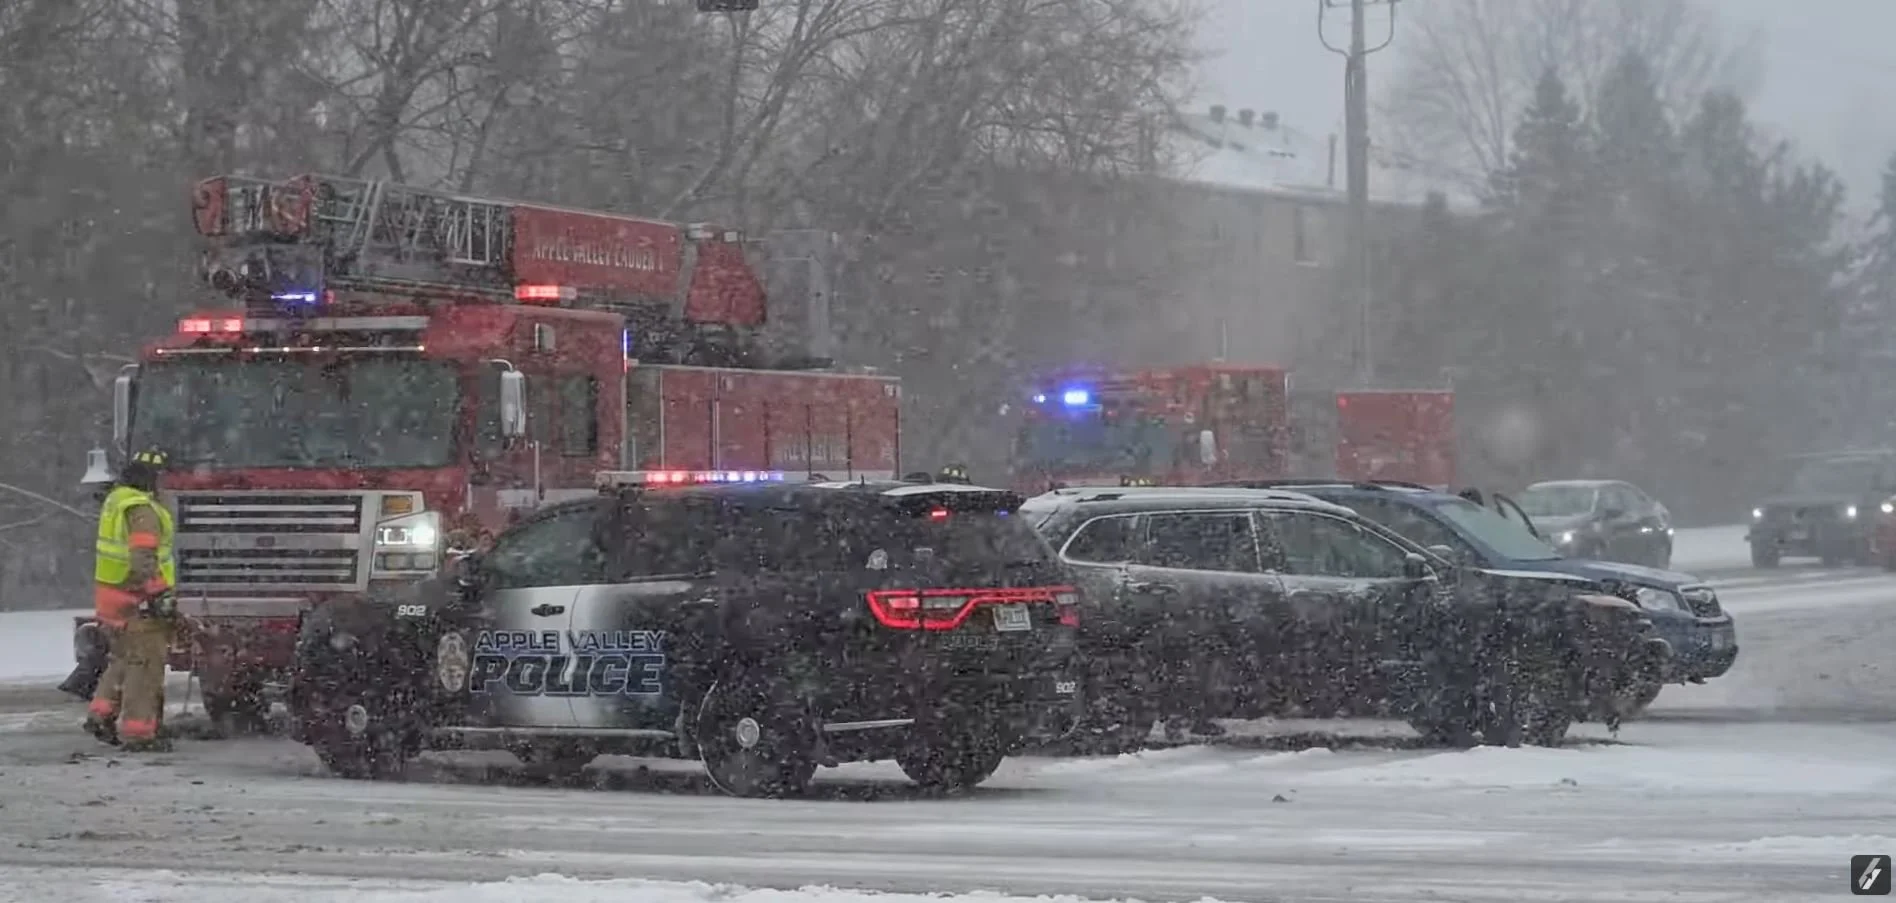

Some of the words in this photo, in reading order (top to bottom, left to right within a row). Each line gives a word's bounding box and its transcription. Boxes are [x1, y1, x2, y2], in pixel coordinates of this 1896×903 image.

[533, 236, 569, 261] APPLE
[572, 239, 613, 267] VALLEY
[398, 605, 426, 616] 902
[475, 630, 560, 651] APPLE
[567, 630, 666, 651] VALLEY
[469, 653, 666, 695] POLICE
[1055, 681, 1076, 693] 902
